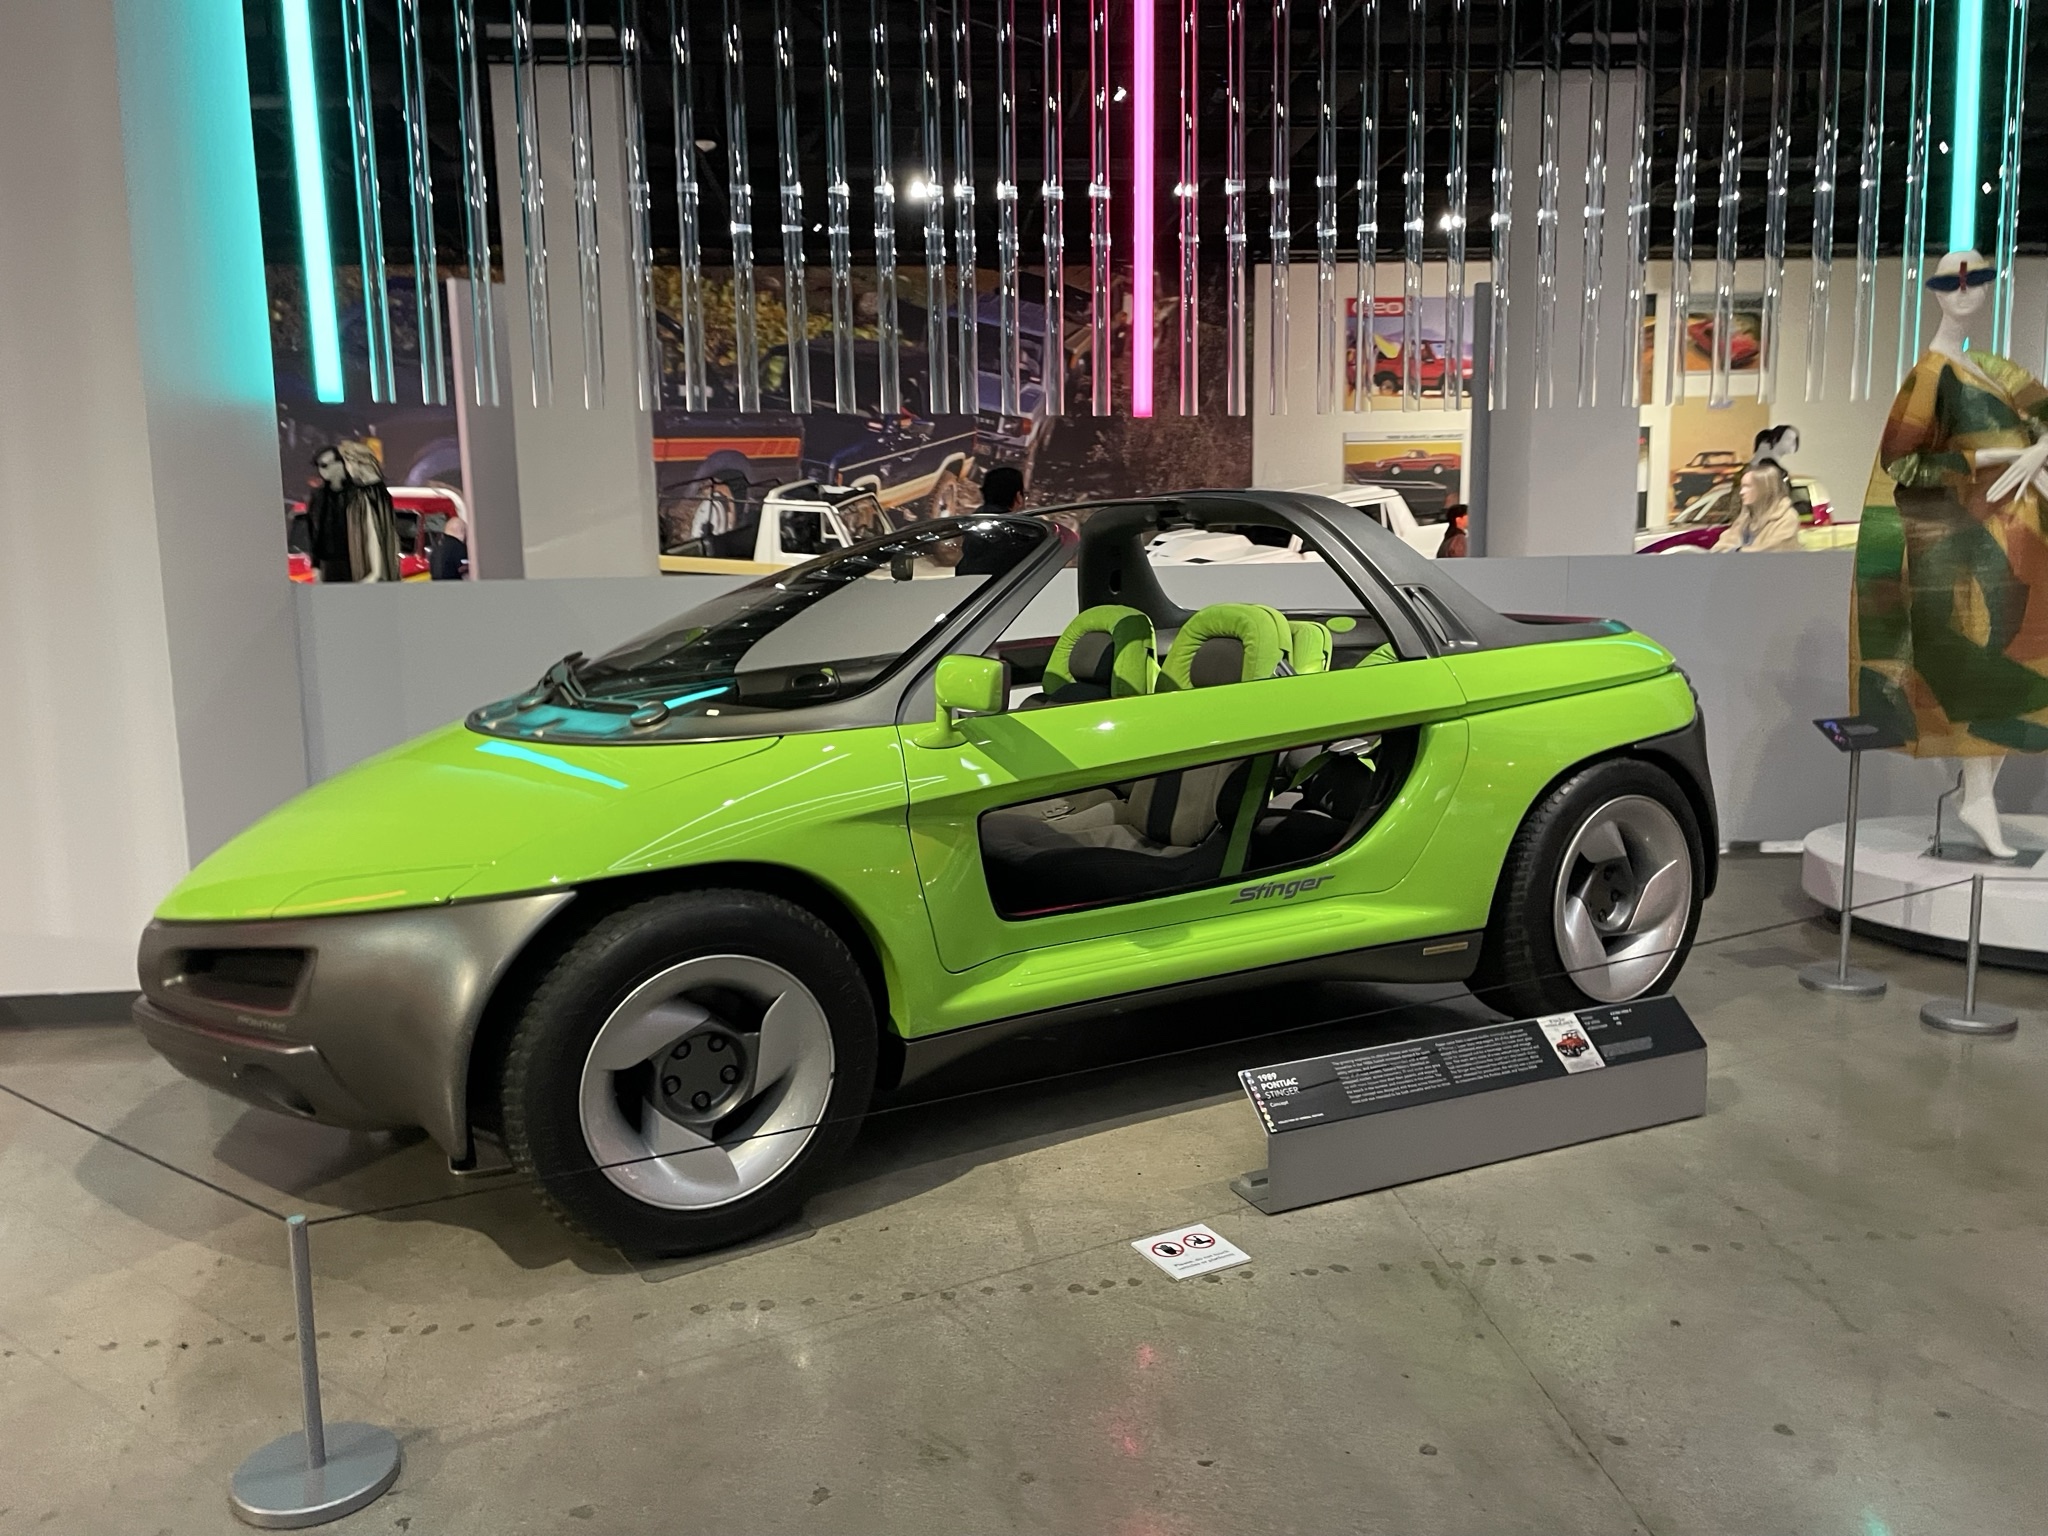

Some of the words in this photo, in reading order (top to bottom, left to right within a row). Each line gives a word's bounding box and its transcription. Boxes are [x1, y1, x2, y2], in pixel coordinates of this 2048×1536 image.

[1230, 875, 1336, 905] Stinger
[1257, 1072, 1277, 1083] 1989
[1260, 1077, 1299, 1091] PONTIAC
[1264, 1086, 1300, 1100] STINGER
